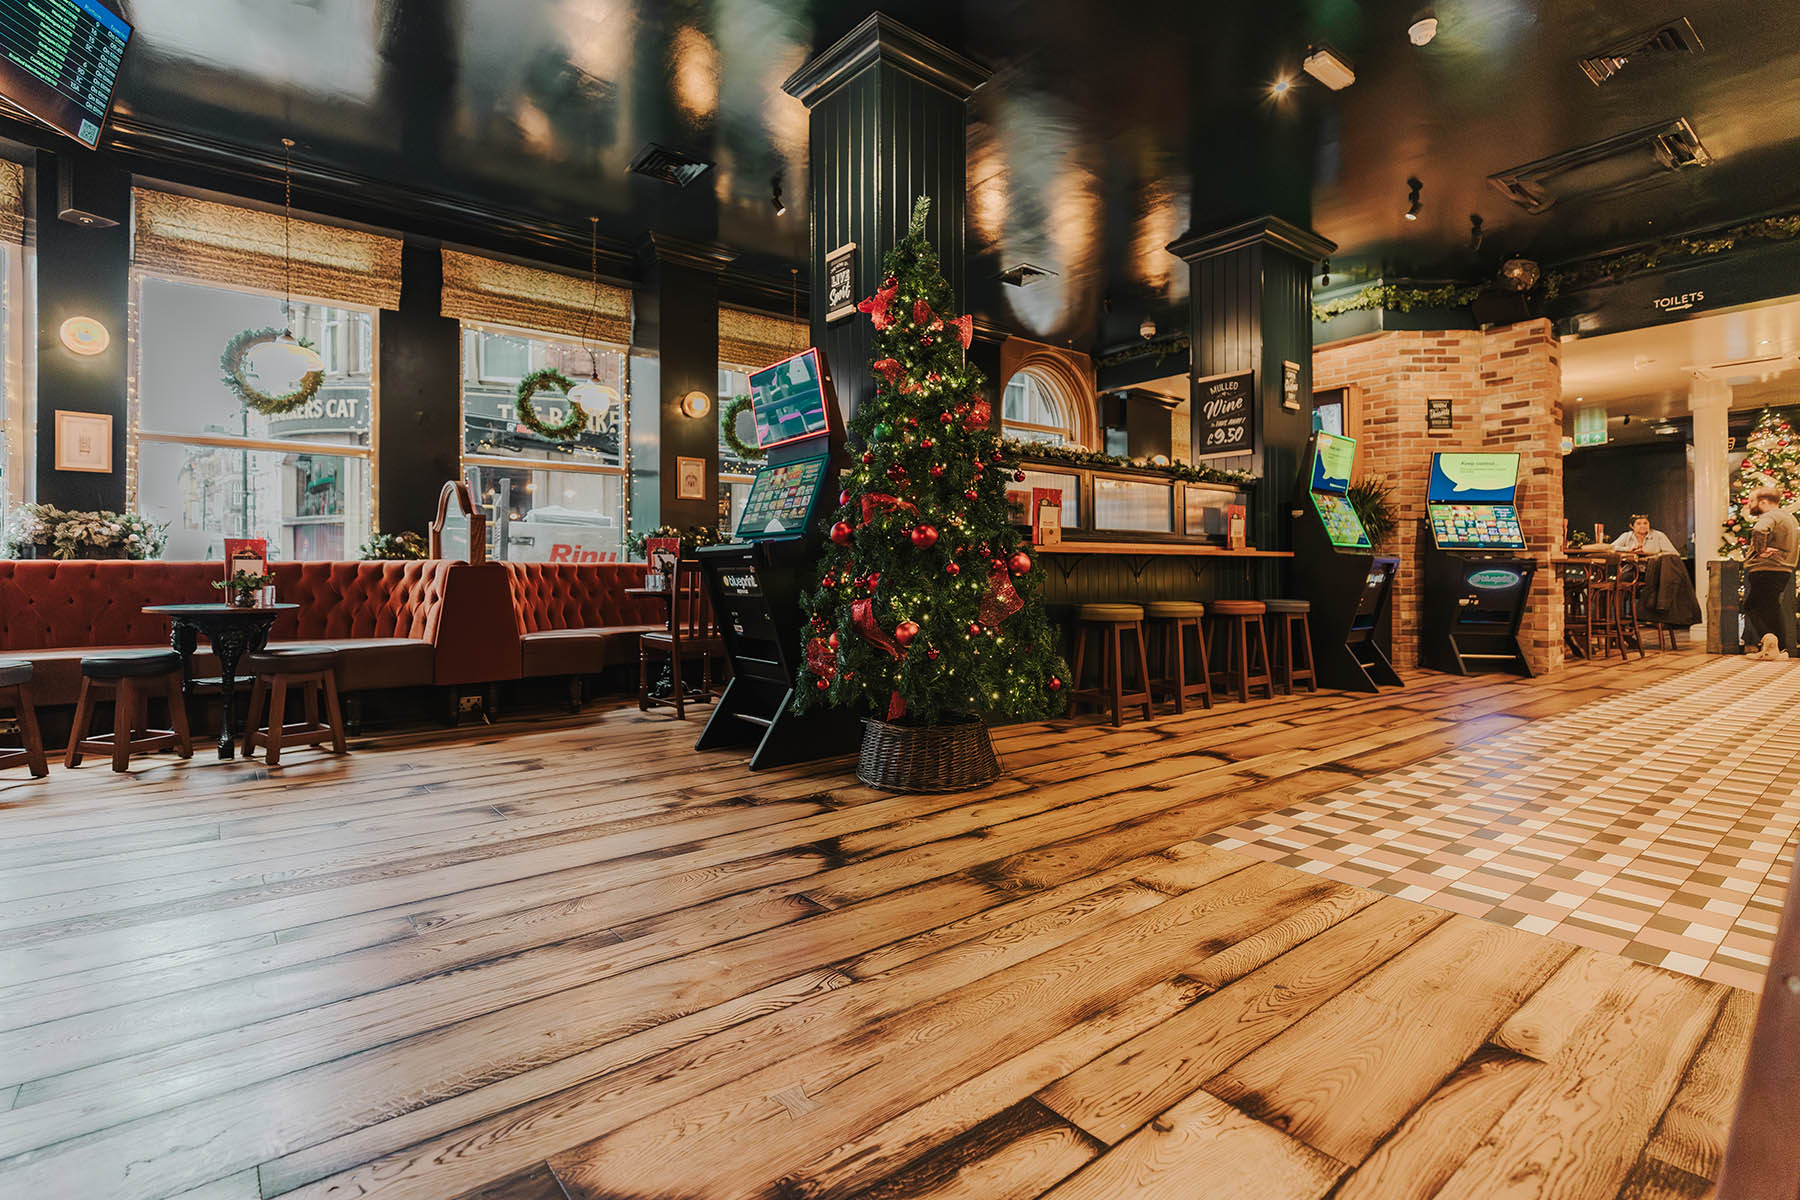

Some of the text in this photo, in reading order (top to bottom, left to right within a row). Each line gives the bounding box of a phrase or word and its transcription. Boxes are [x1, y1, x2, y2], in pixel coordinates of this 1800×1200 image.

[1653, 291, 1704, 308] TOILETS
[1210, 381, 1239, 395] MULLED
[326, 399, 359, 418] CAT
[1203, 398, 1243, 420] Wine
[1207, 426, 1244, 446] £9.50
